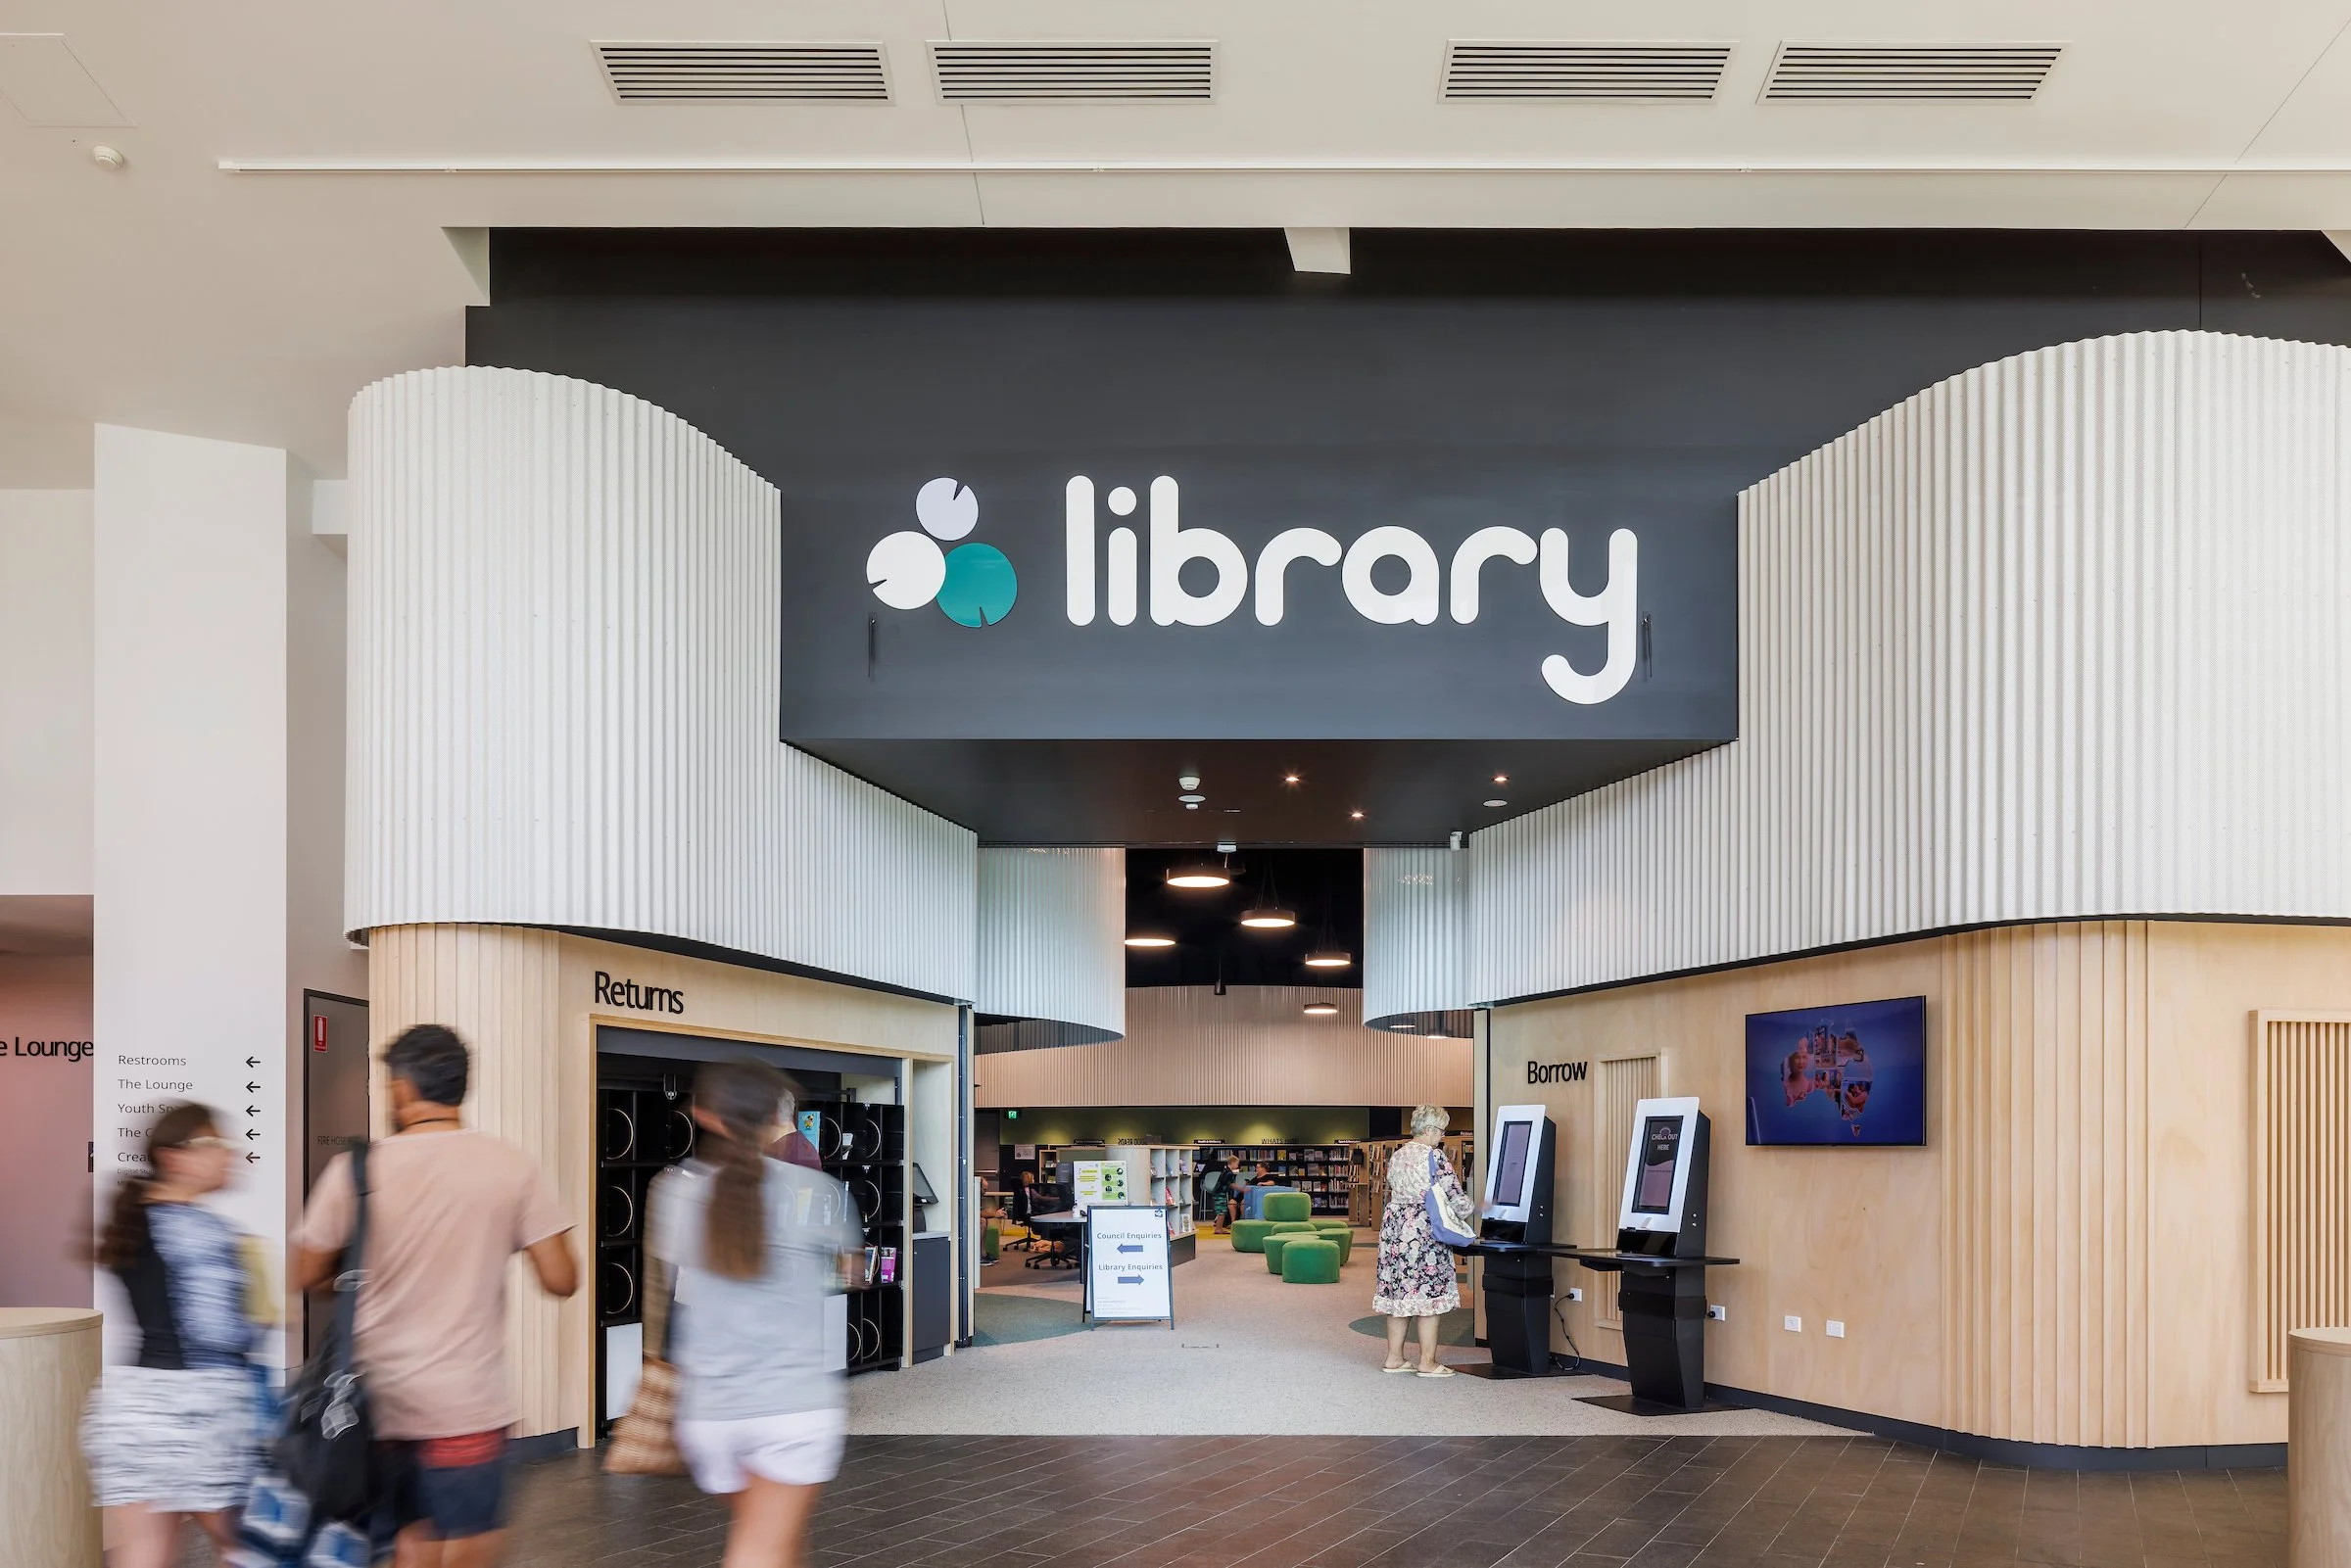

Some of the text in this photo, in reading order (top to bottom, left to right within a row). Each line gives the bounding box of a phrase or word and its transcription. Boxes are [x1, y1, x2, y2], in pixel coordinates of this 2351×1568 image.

[1066, 475, 1638, 705] library
[595, 971, 684, 1015] Returns
[15, 1036, 94, 1063] Lounge
[118, 1055, 187, 1067] Restrooms
[1527, 1061, 1588, 1084] Borrow
[118, 1079, 193, 1092] The Lounge
[118, 1104, 155, 1114] Youth
[118, 1127, 141, 1138] The
[317, 1135, 330, 1146] FIRE
[1127, 1232, 1162, 1241] Enquiries
[1098, 1263, 1163, 1273] Library Enquiries
